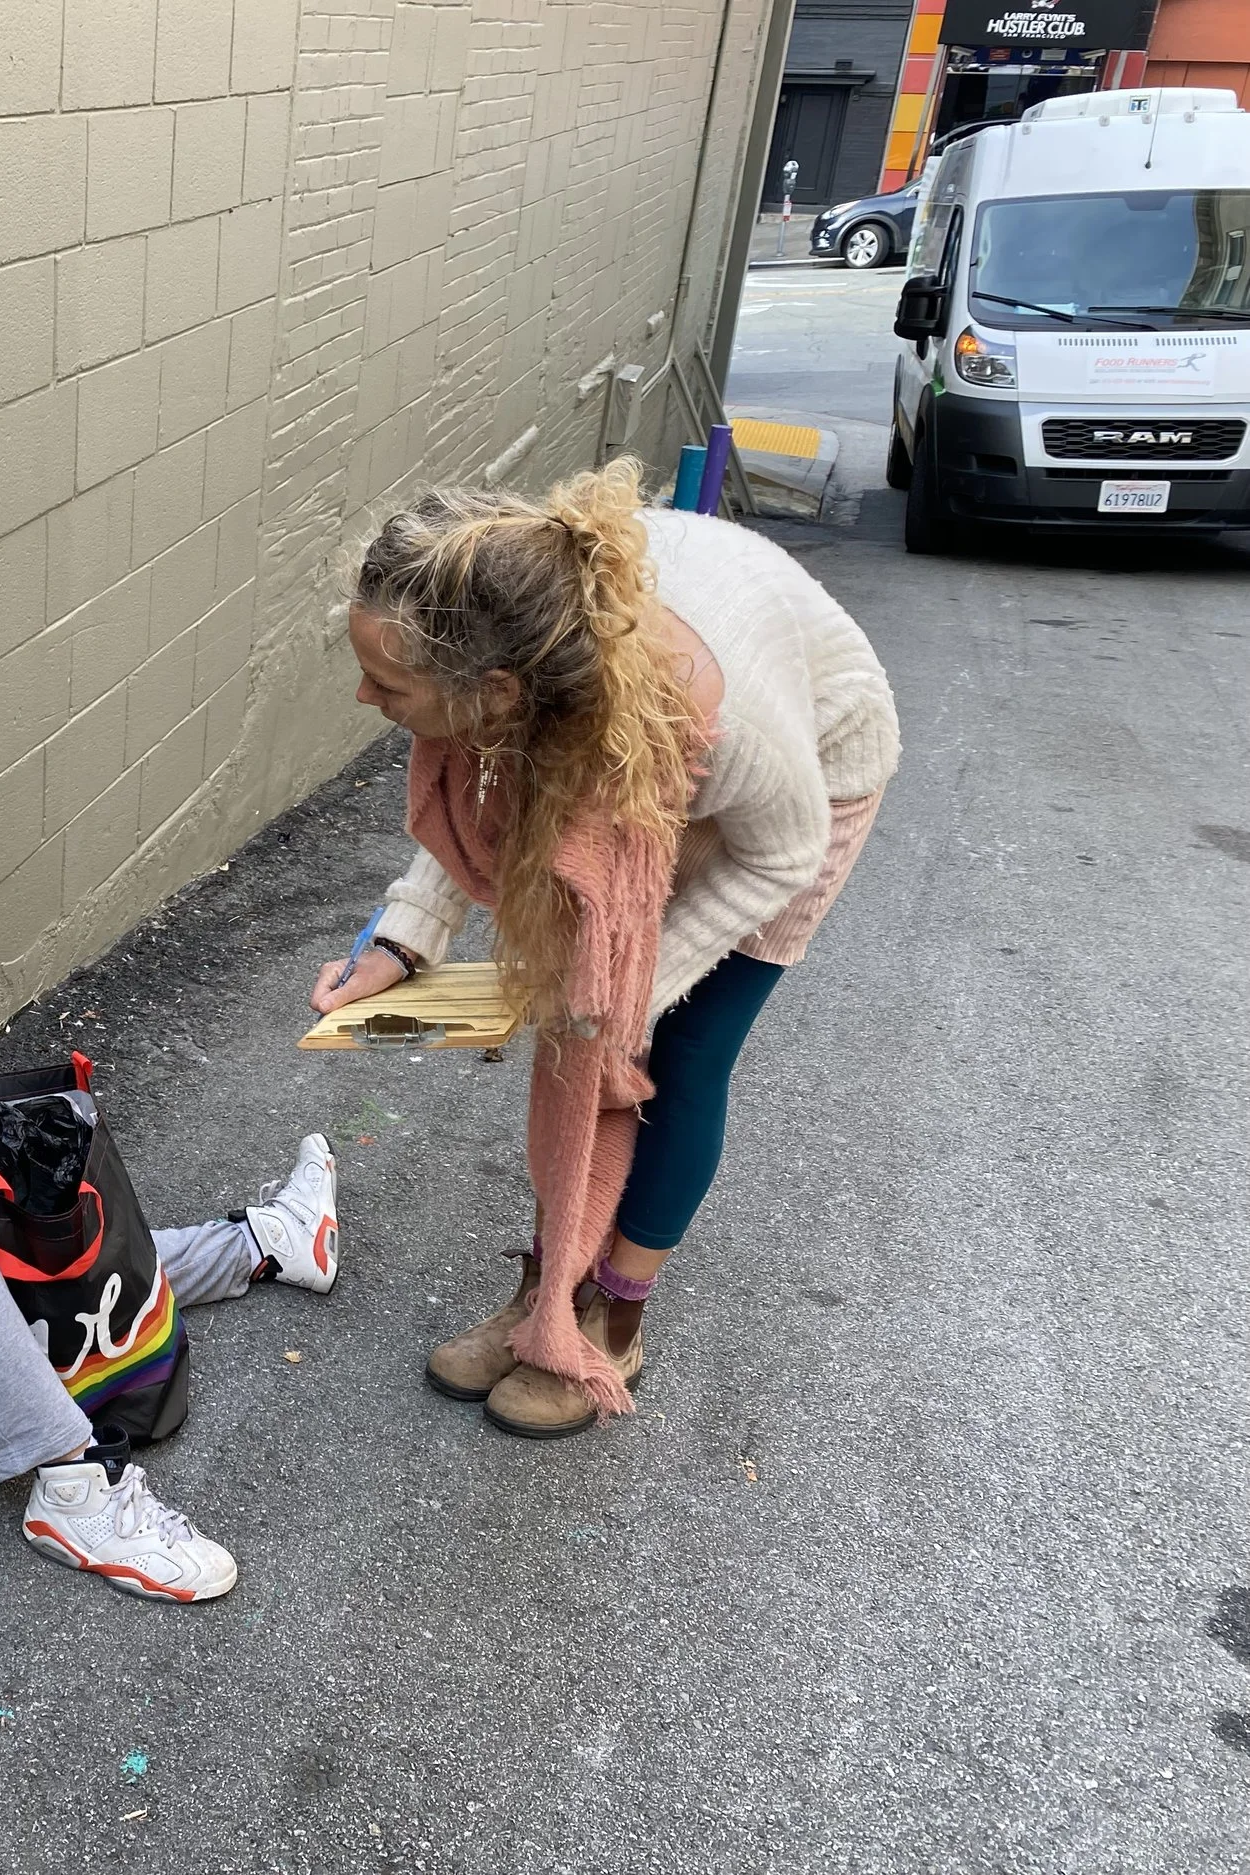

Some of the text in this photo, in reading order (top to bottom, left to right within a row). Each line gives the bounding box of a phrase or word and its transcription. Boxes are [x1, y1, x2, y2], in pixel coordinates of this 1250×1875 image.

[1004, 12, 1037, 20] LARRY
[986, 19, 1046, 33] HUSTLER
[1093, 431, 1193, 444] RAM
